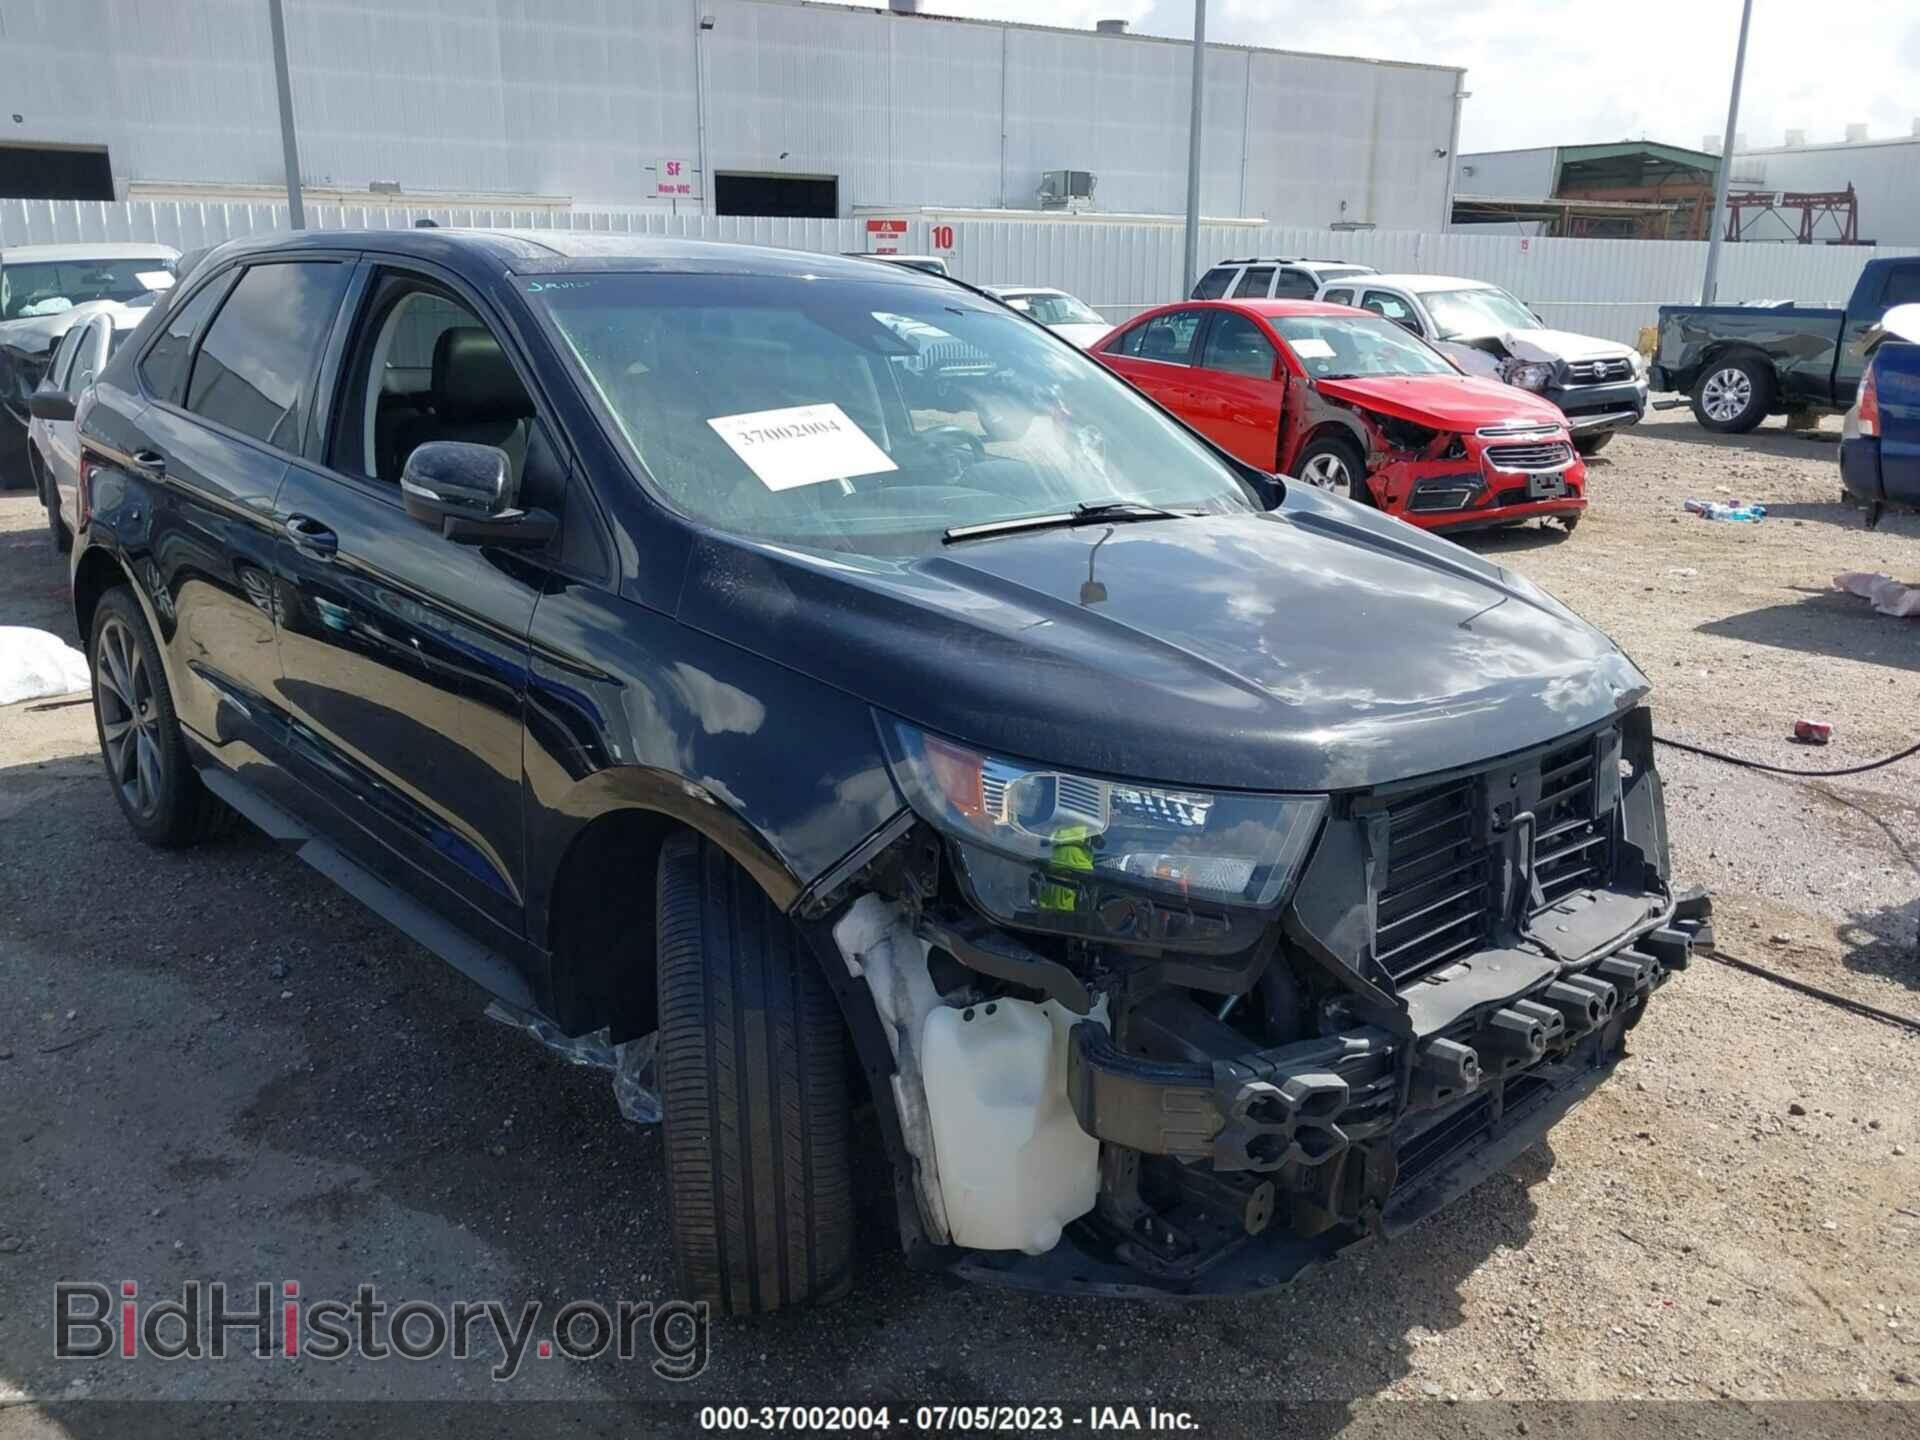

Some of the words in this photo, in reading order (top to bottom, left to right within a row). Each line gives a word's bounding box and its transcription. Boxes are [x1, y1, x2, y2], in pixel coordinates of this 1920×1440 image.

[666, 161, 681, 176] SF
[932, 226, 953, 249] 10
[738, 420, 841, 446] 37002004
